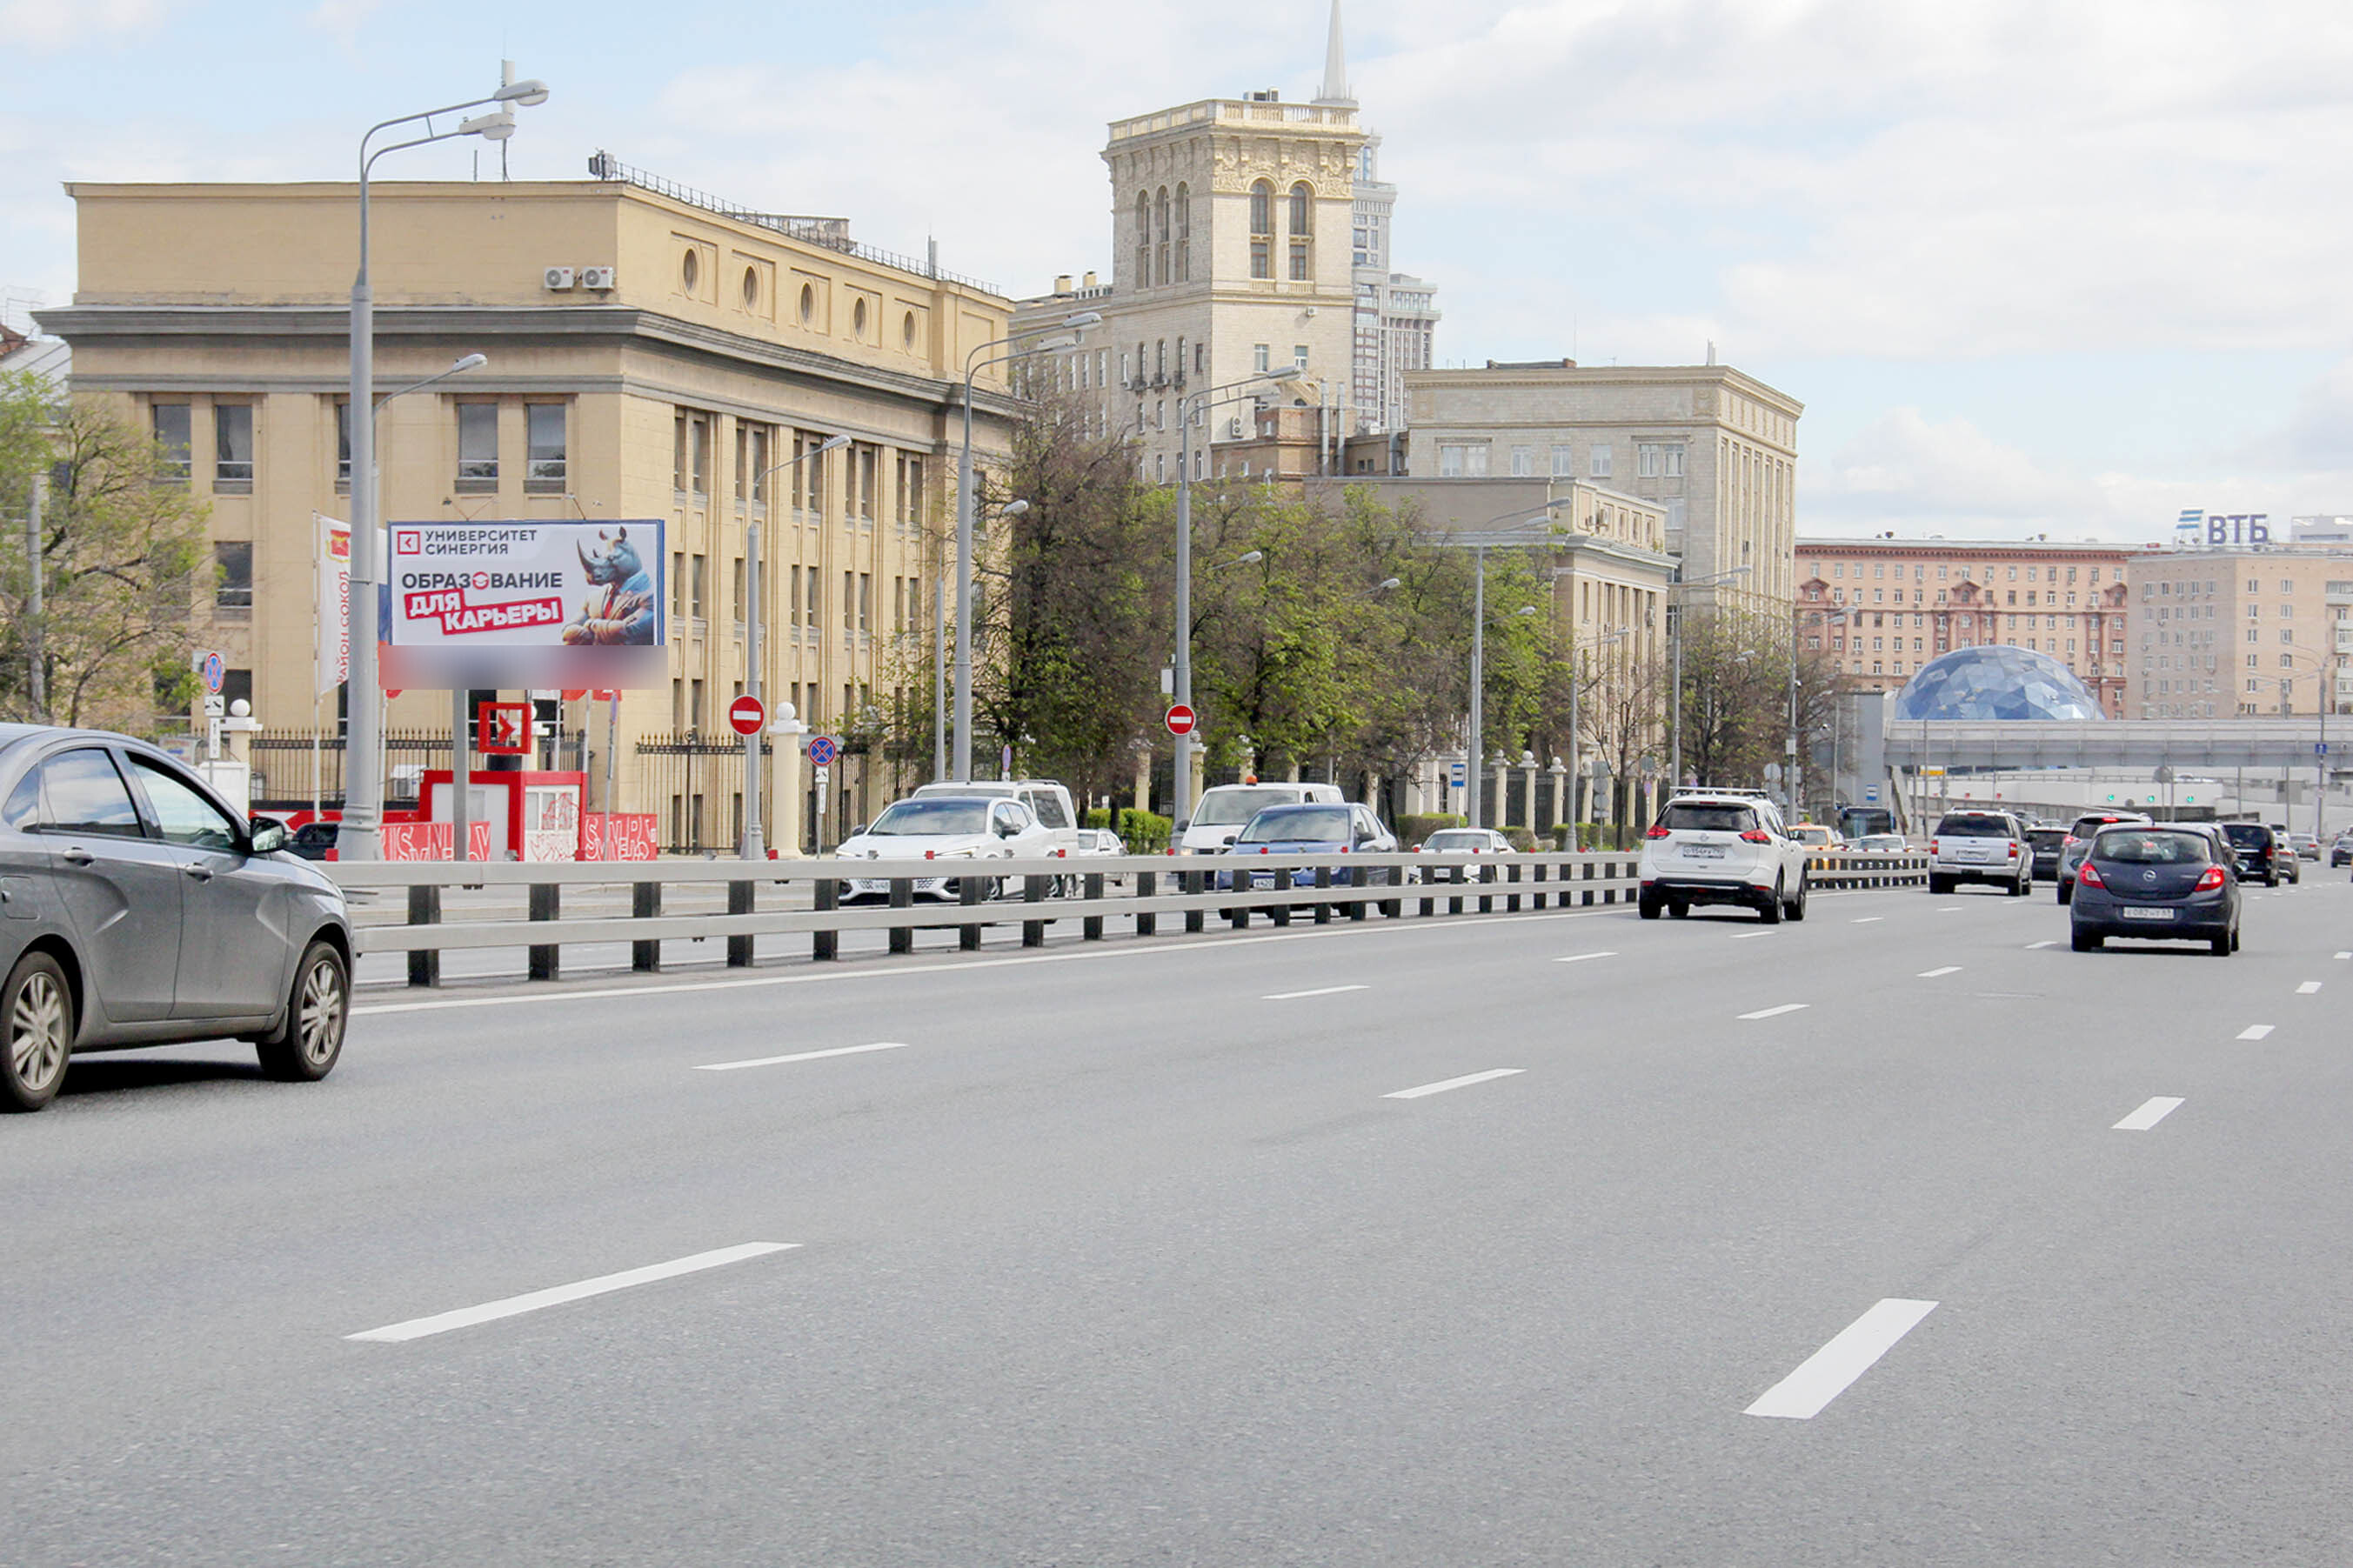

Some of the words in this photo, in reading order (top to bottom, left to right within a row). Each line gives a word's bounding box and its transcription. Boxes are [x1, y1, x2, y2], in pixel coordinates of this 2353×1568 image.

[425, 530, 537, 542] УНИВЕРСИТЕТ
[2208, 514, 2269, 544] ВТБ
[425, 544, 509, 555] СИНЕРГИЯ
[402, 570, 563, 590] ОБРАЗОВАНИЕ
[338, 570, 349, 630] СОКОЛ
[410, 592, 462, 617] ДЛЯ
[445, 601, 560, 631] КАРЬЕРЫ
[336, 632, 349, 684] РАЙОН
